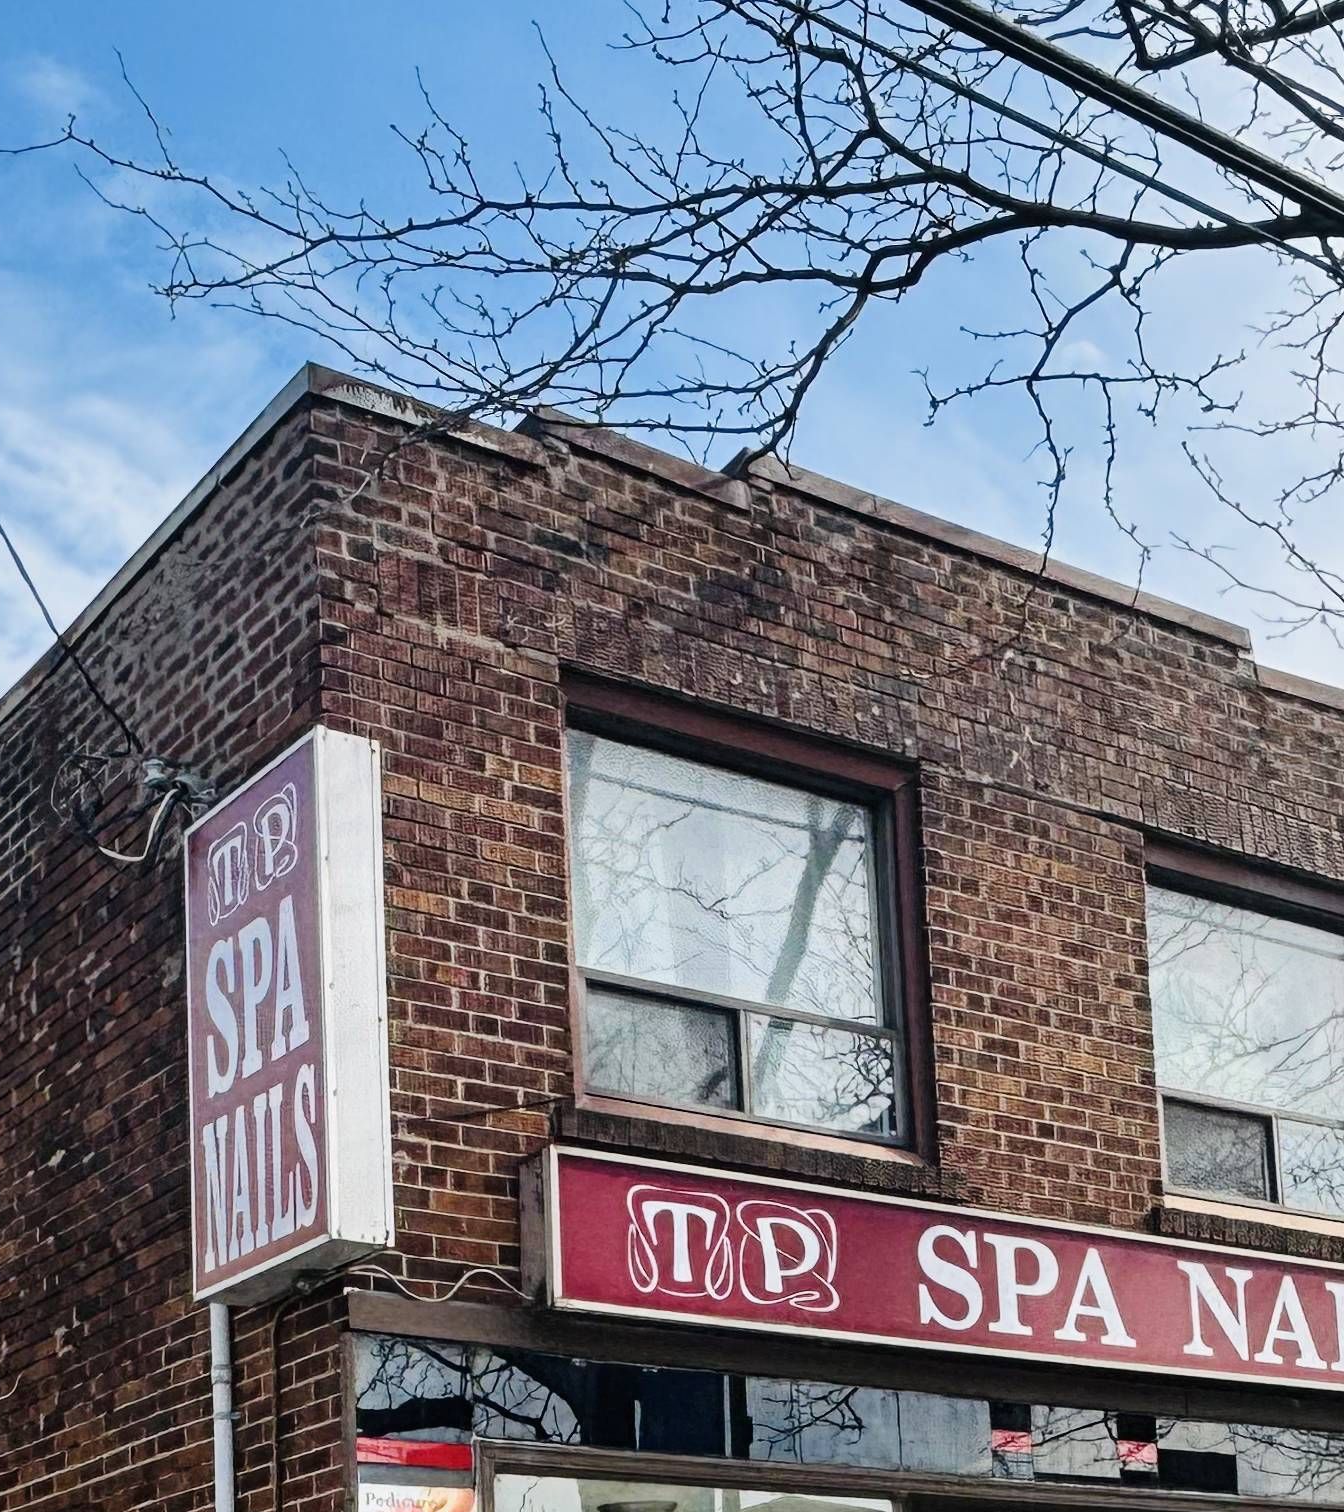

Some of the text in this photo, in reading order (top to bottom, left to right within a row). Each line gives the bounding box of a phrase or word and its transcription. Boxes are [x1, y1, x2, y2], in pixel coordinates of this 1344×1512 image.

[207, 895, 310, 1098] SPA
[203, 1063, 318, 1273] NAILS
[916, 1225, 1136, 1348] SPA
